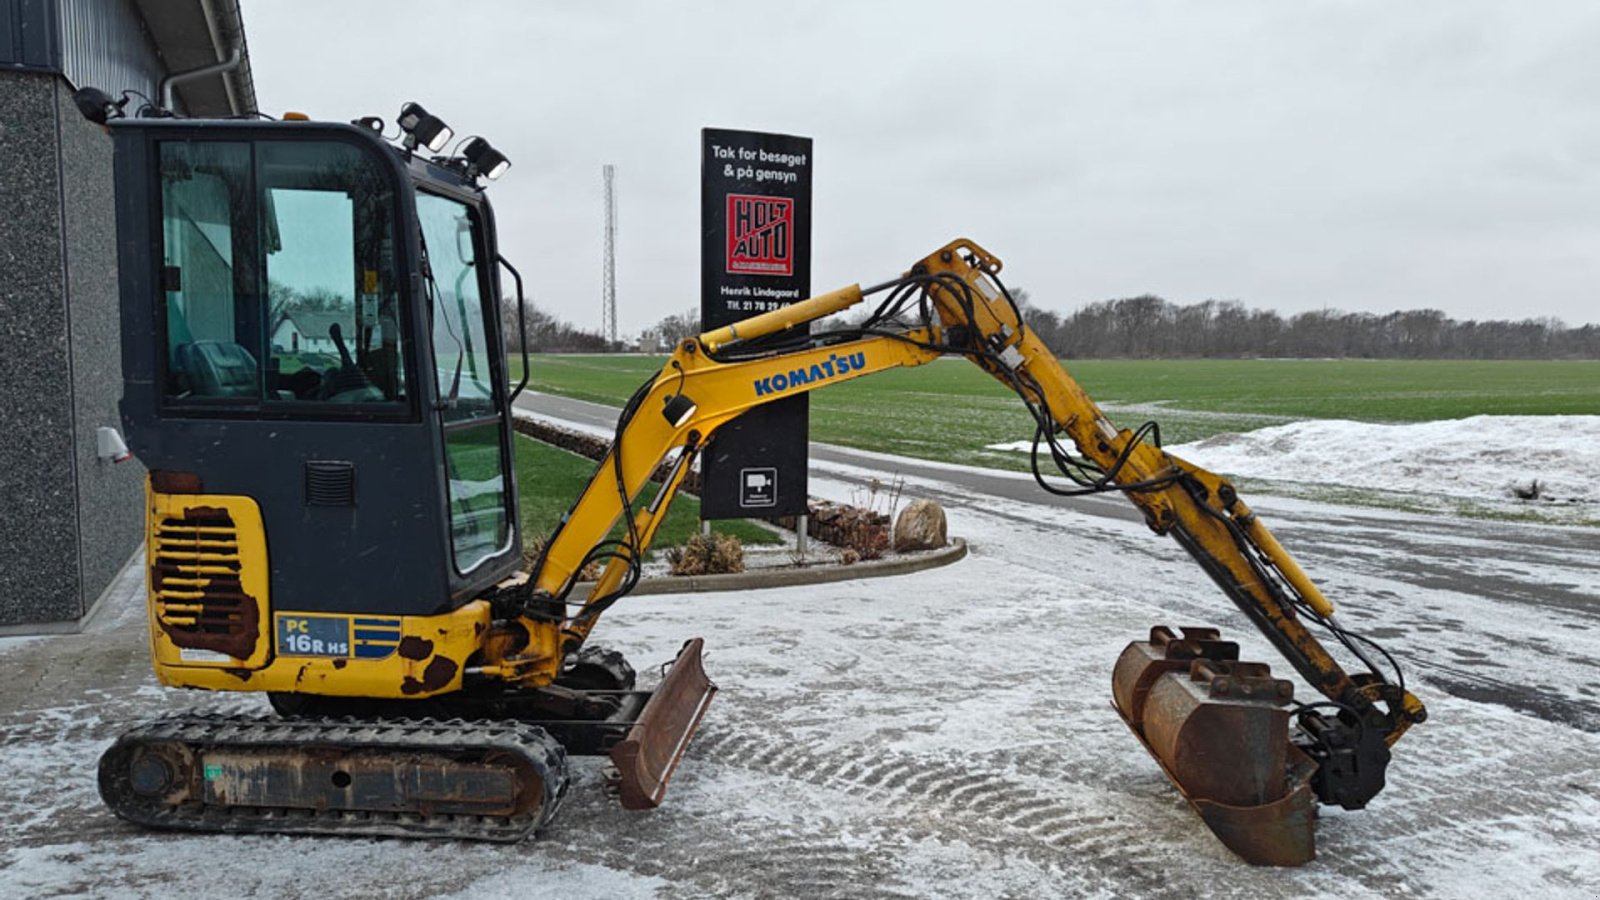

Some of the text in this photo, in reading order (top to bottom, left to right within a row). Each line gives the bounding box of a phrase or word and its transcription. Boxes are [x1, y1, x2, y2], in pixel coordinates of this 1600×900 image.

[712, 145, 806, 167] Tak for besøget
[723, 164, 797, 184] & på gensyn
[735, 200, 787, 238] HOLT
[733, 221, 787, 259] AUTO
[720, 286, 799, 299] Henrik Lindegaard
[742, 301, 753, 311] 21
[754, 301, 766, 311] 78
[754, 352, 866, 396] KOMATSU
[286, 620, 308, 633] PC
[328, 642, 348, 654] HS
